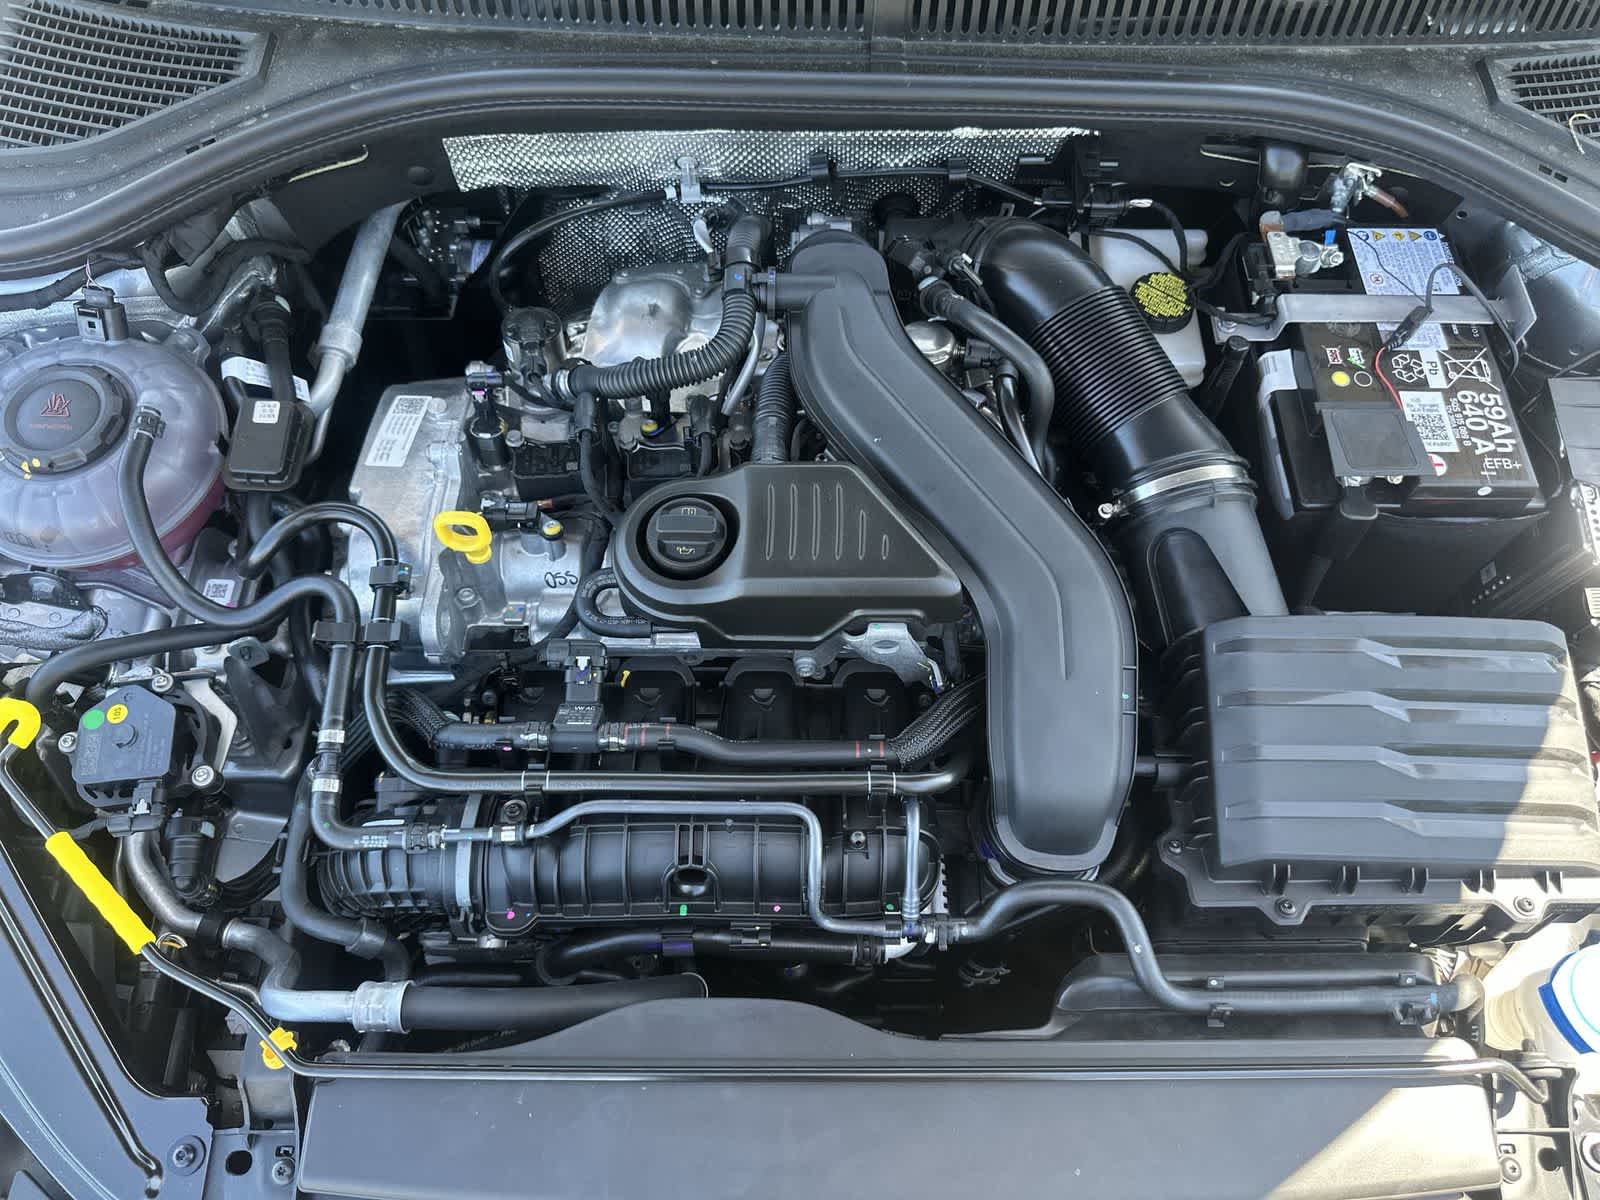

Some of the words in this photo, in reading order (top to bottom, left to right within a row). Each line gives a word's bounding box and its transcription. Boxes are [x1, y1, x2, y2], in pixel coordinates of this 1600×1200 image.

[1426, 361, 1438, 376] Pb
[1457, 390, 1489, 431] 640
[1480, 393, 1516, 452] 59Ah
[1471, 437, 1495, 455] A
[1484, 457, 1522, 470] EFB+
